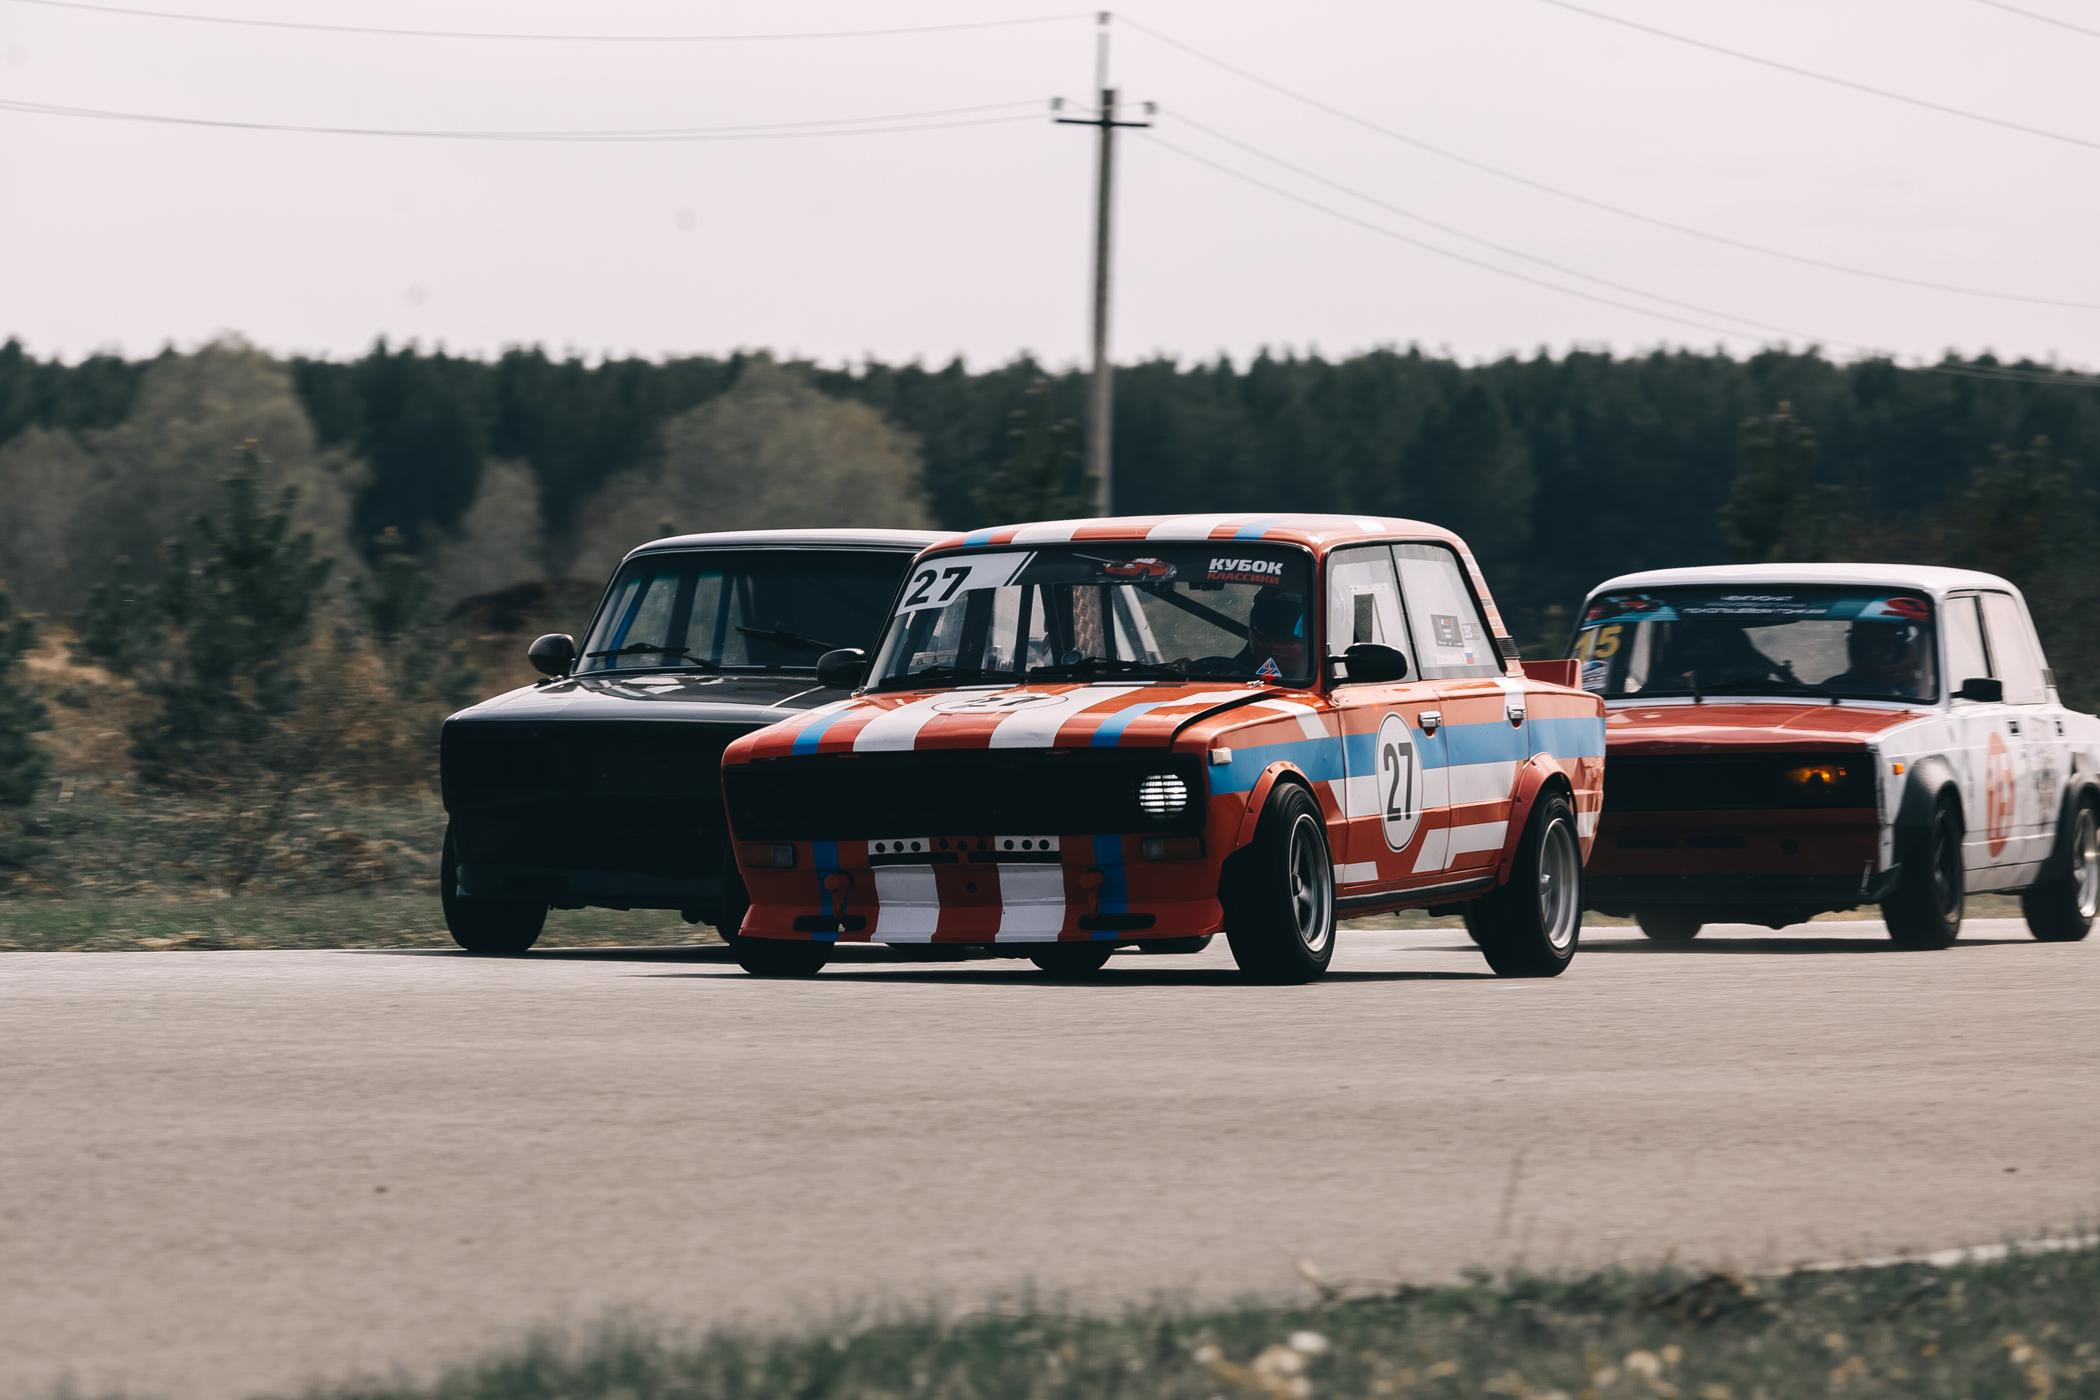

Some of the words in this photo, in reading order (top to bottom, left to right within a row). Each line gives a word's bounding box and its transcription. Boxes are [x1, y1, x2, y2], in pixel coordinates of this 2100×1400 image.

[1206, 571, 1281, 585] КЛАССИКИ
[1209, 558, 1284, 575] КУБОК
[904, 566, 972, 607] 27
[1574, 625, 1624, 661] 15
[948, 696, 1050, 707] 27
[1383, 742, 1412, 821] 27
